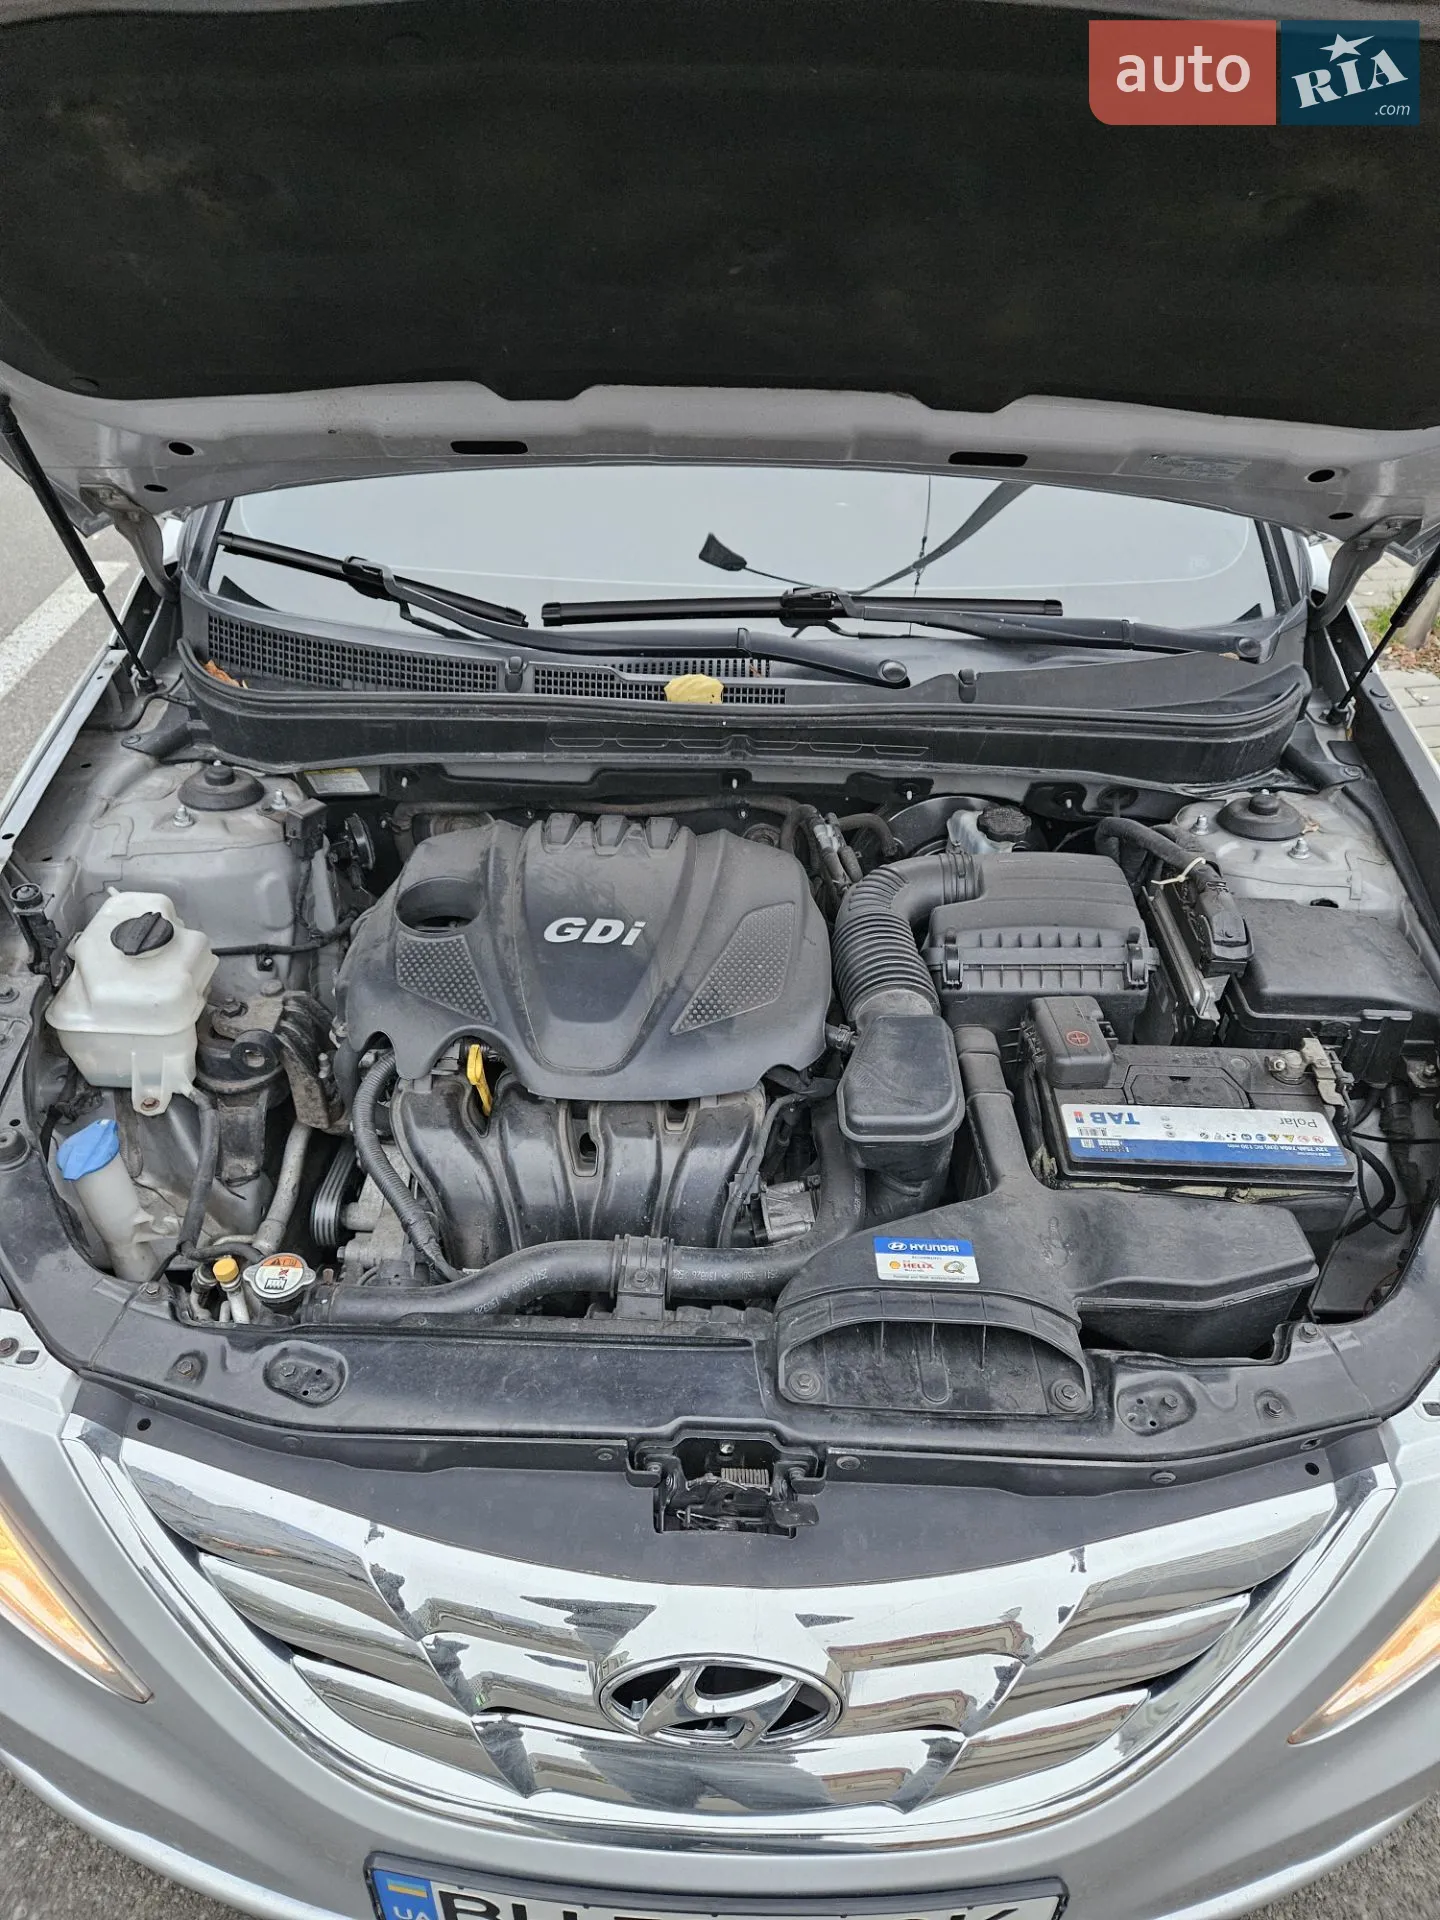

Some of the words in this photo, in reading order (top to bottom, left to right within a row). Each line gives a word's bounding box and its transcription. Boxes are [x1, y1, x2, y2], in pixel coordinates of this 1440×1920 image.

[543, 917, 647, 946] GDi
[1089, 1111, 1141, 1126] TAB
[1280, 1117, 1318, 1128] Polar
[909, 1243, 961, 1253] HYUNDAI
